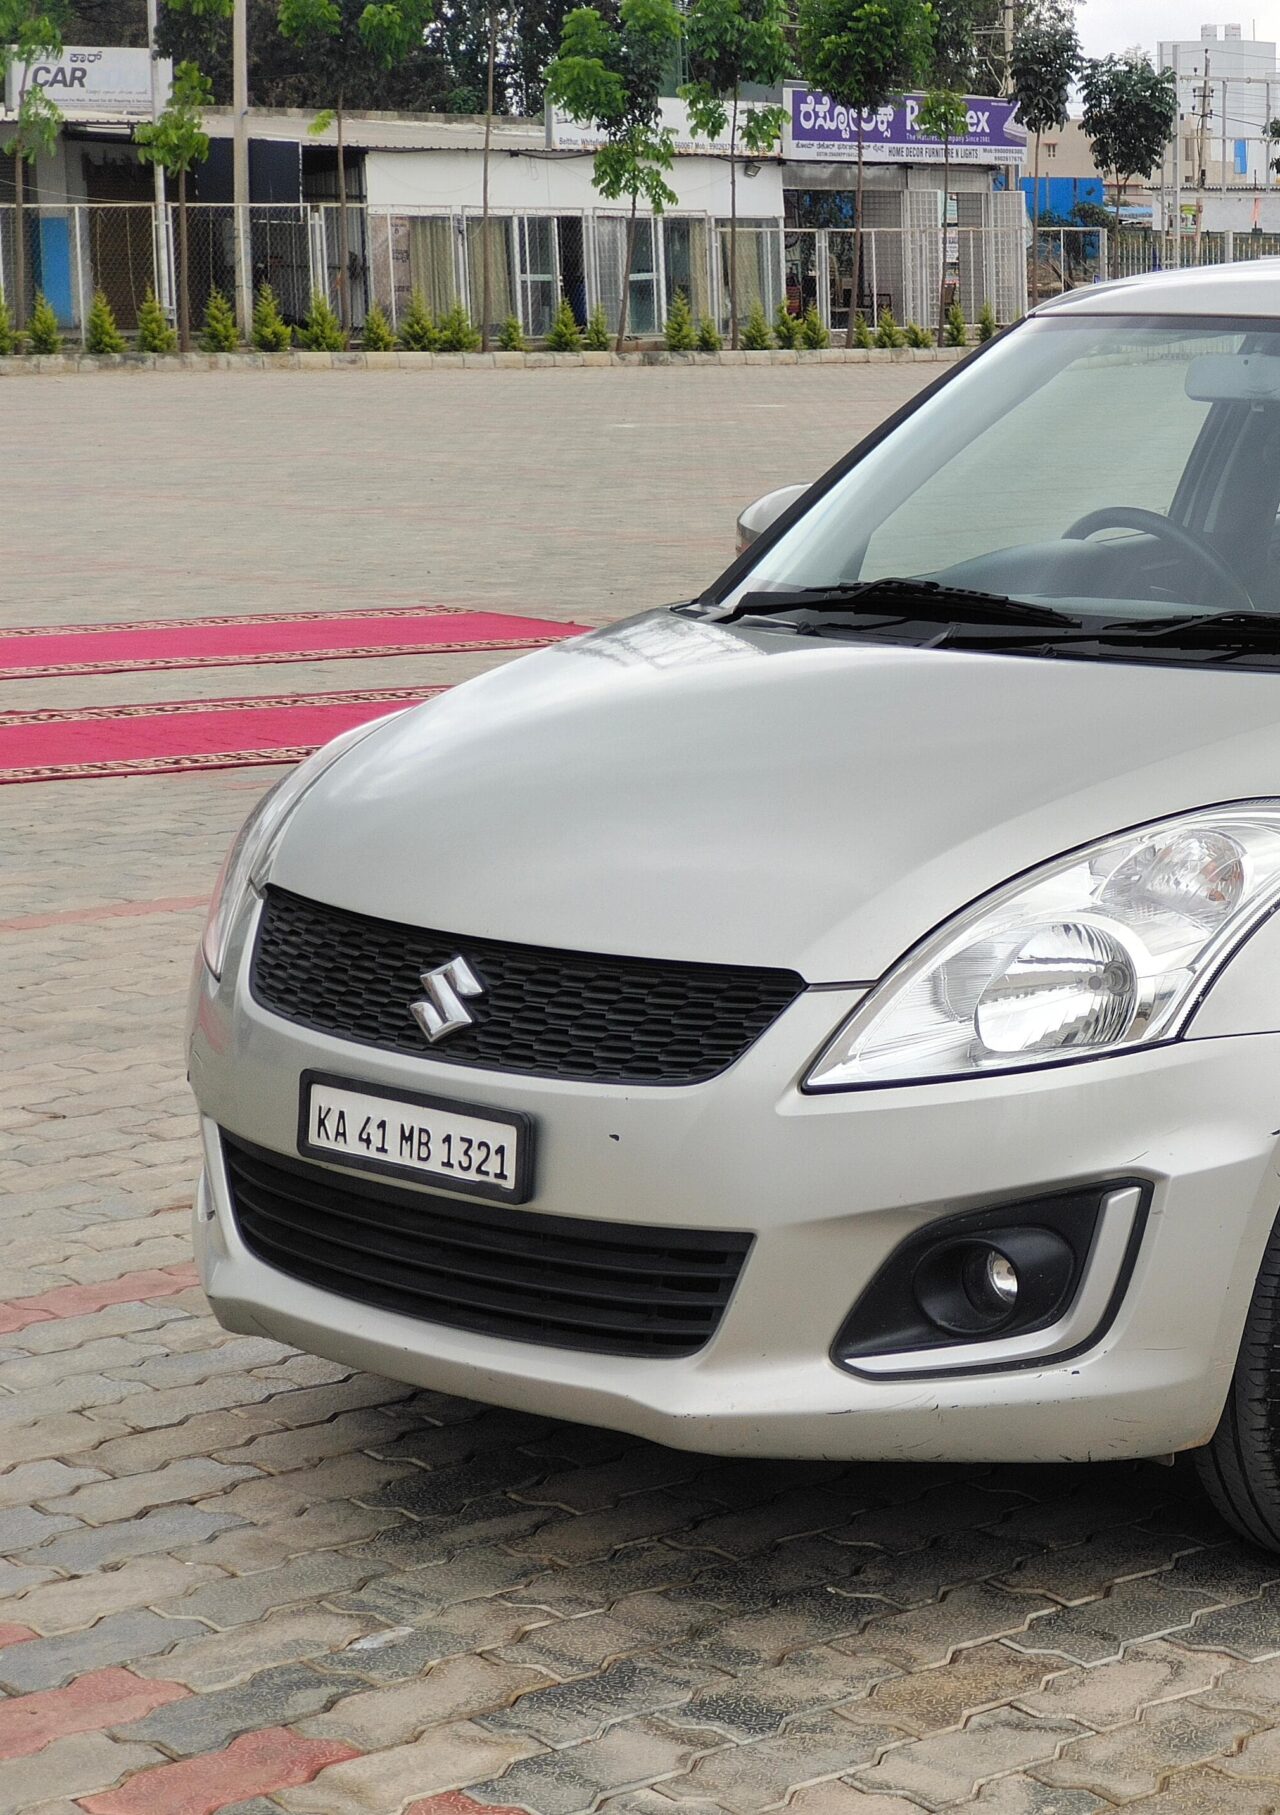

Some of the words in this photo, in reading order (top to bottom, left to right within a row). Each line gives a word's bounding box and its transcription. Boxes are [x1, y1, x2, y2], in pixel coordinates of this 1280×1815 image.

[69, 51, 103, 63] ಕಾರ್
[31, 65, 87, 88] CAR
[888, 147, 904, 157] HOME
[905, 147, 924, 158] DECOR
[960, 148, 978, 159] LIGHTS
[317, 1105, 347, 1145] KA
[358, 1116, 388, 1154] 41
[399, 1123, 431, 1162] MB
[441, 1133, 508, 1181] 1321
